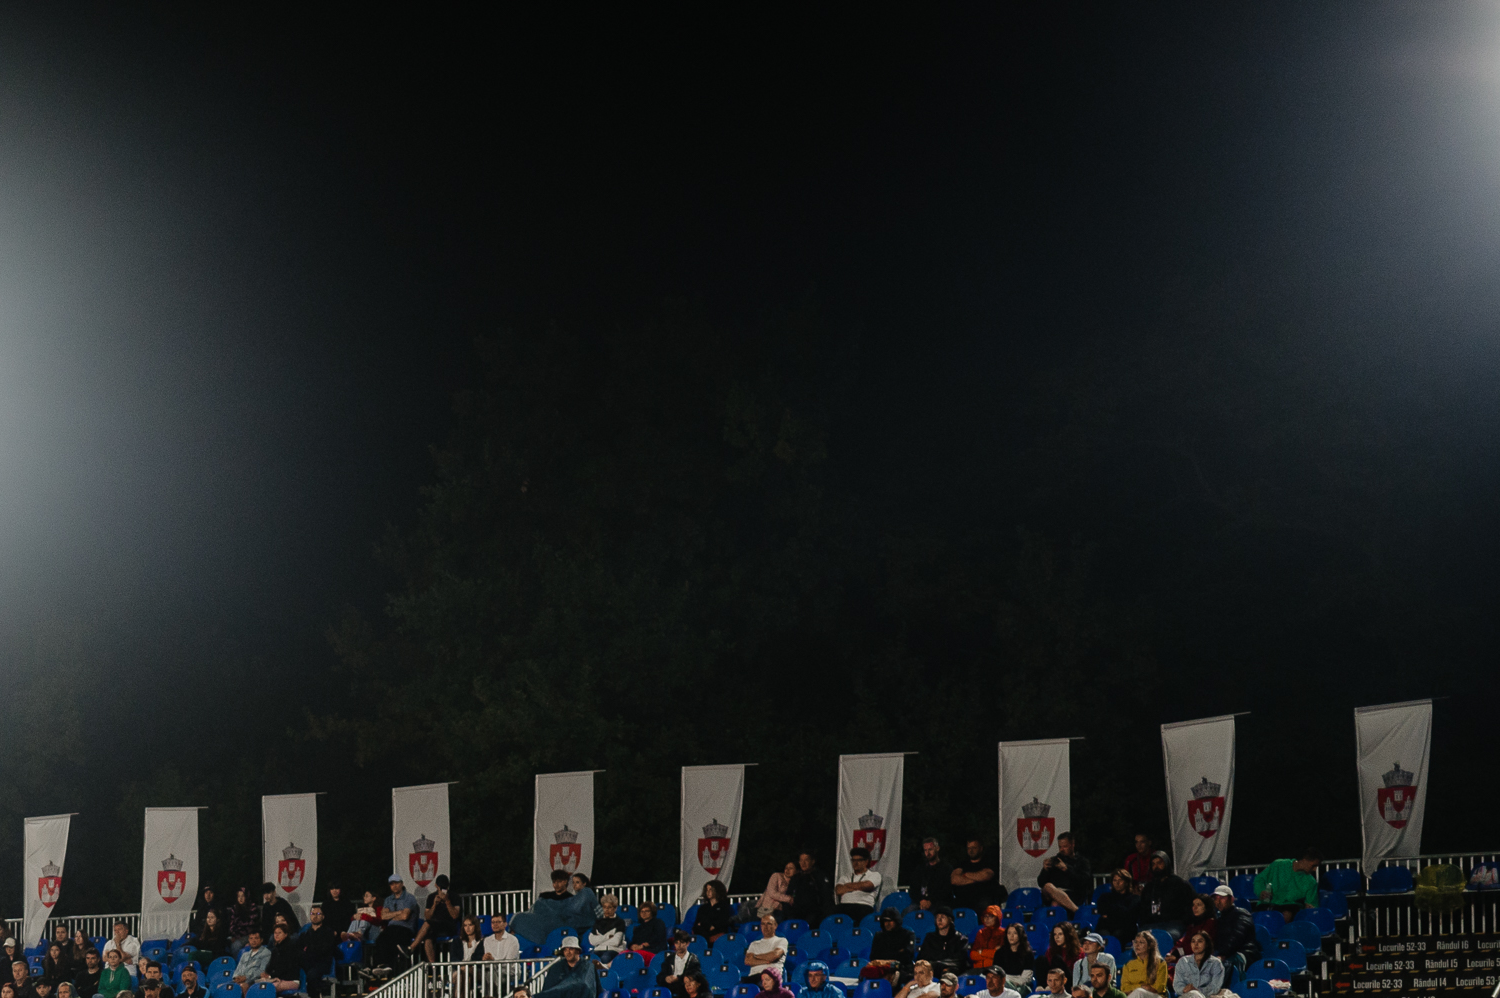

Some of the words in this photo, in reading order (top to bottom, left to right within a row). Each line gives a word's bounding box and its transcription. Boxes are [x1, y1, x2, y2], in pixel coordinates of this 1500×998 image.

[1378, 943, 1405, 952] Locurile
[1406, 942, 1426, 951] 52-33
[1437, 940, 1460, 950] Rândul
[1461, 940, 1469, 950] 16
[1366, 961, 1393, 971] Locurile
[1394, 960, 1415, 970] 52-33
[1425, 959, 1449, 969] Rândul
[1450, 959, 1458, 968] 15
[1466, 958, 1494, 968] Locurile
[1353, 980, 1380, 989] Locurile
[1382, 979, 1402, 989] 52-33
[1413, 977, 1438, 988] Rândul
[1439, 977, 1447, 987] 14
[1456, 977, 1484, 987] Locurile
